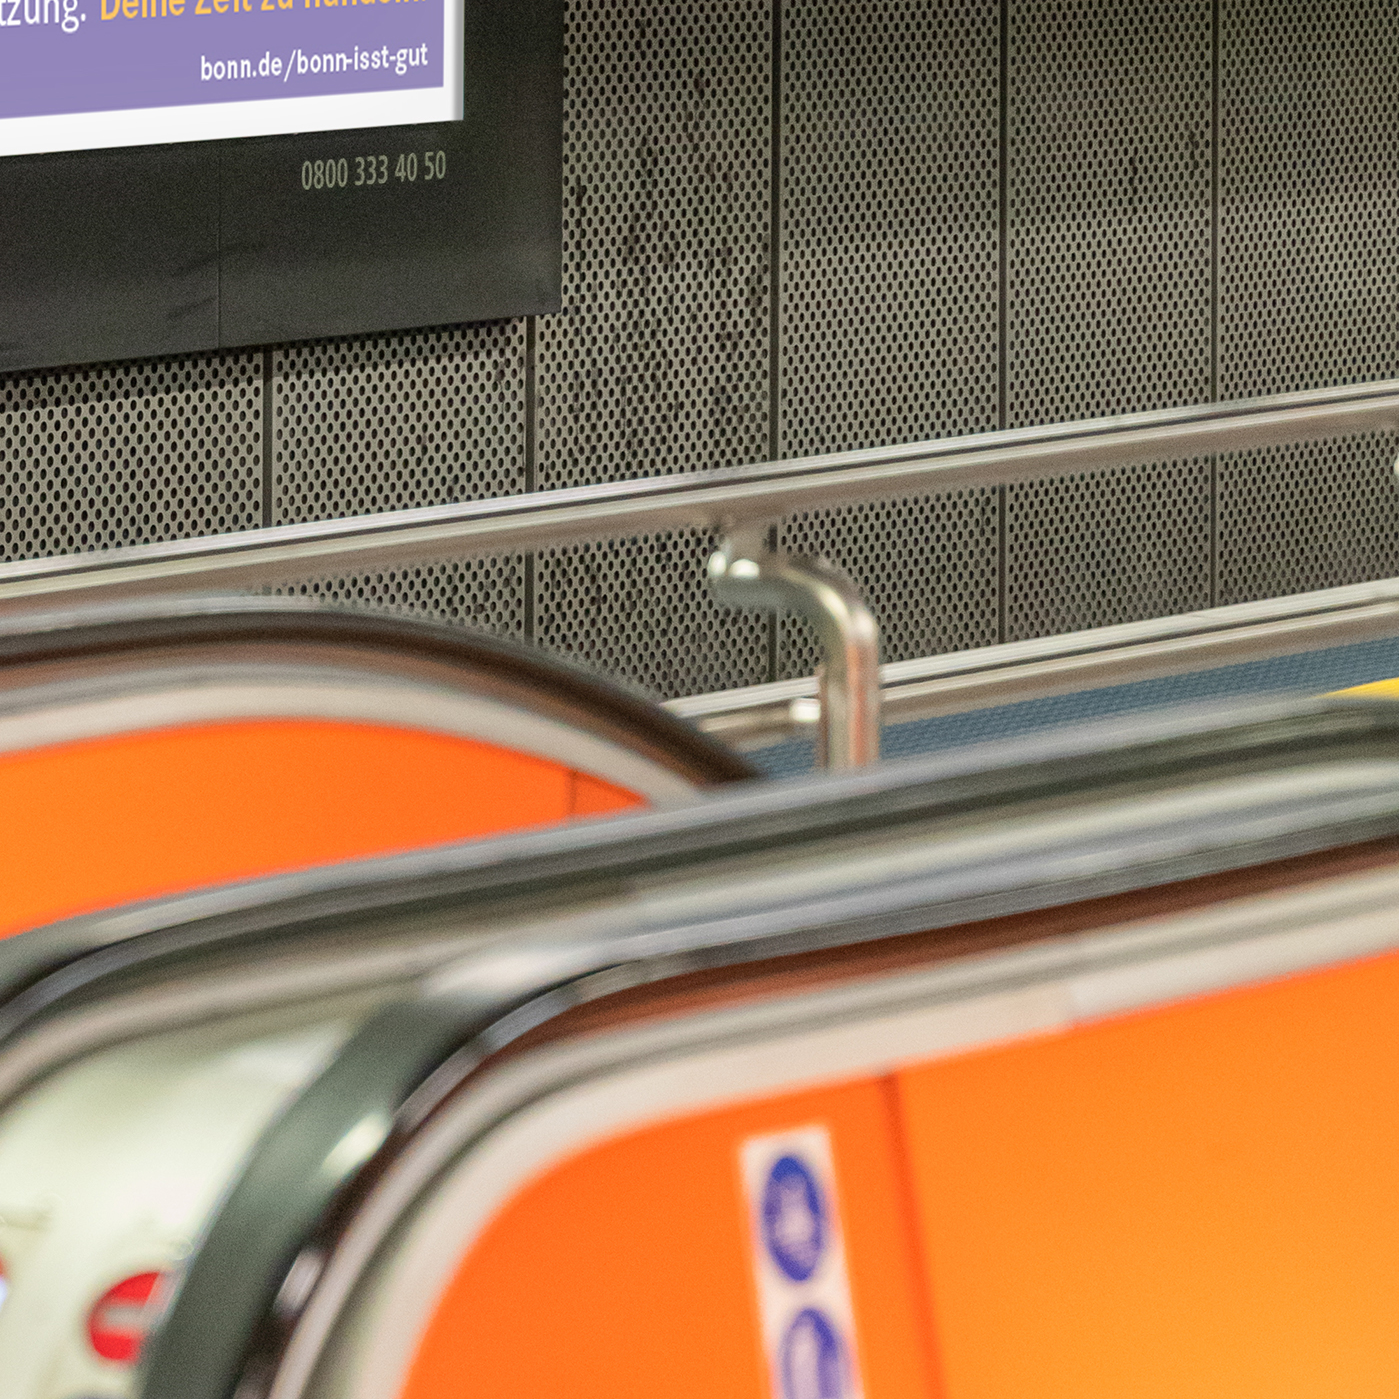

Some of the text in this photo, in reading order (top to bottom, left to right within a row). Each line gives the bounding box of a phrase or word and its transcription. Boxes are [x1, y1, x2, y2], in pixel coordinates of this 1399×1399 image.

[200, 42, 429, 83] bonn.de/bonn-isst-gut
[301, 150, 446, 190] 0800 333 40 50
